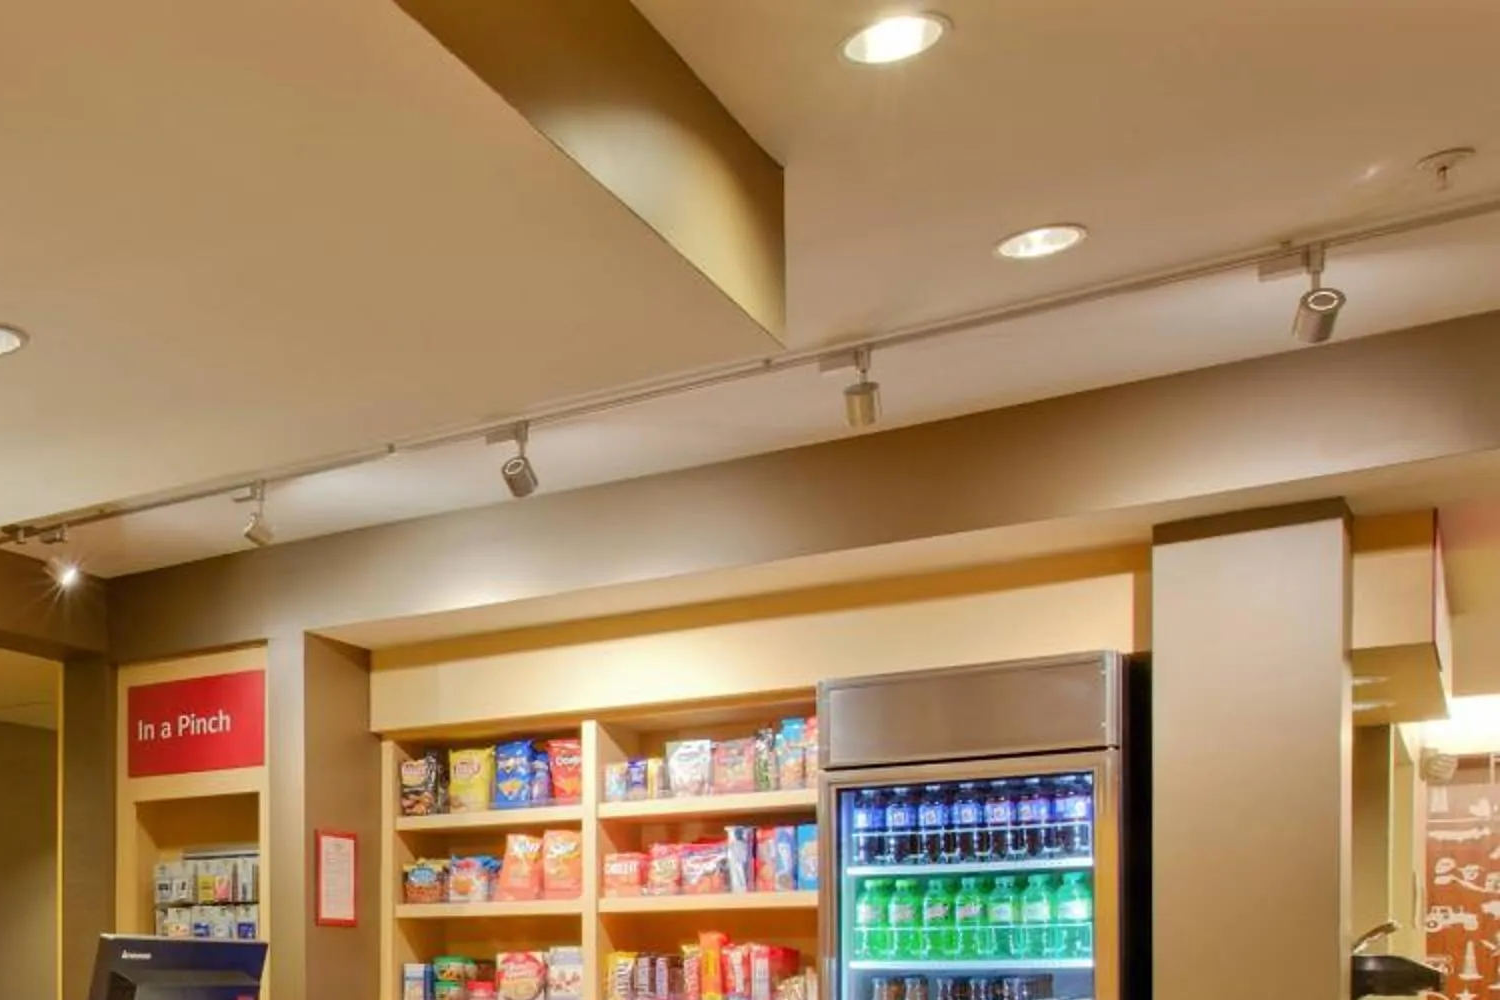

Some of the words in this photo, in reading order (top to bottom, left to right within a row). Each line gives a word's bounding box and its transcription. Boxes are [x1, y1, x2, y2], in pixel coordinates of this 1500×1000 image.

[137, 719, 155, 741] In
[160, 721, 171, 739] a
[177, 709, 231, 737] Pinch
